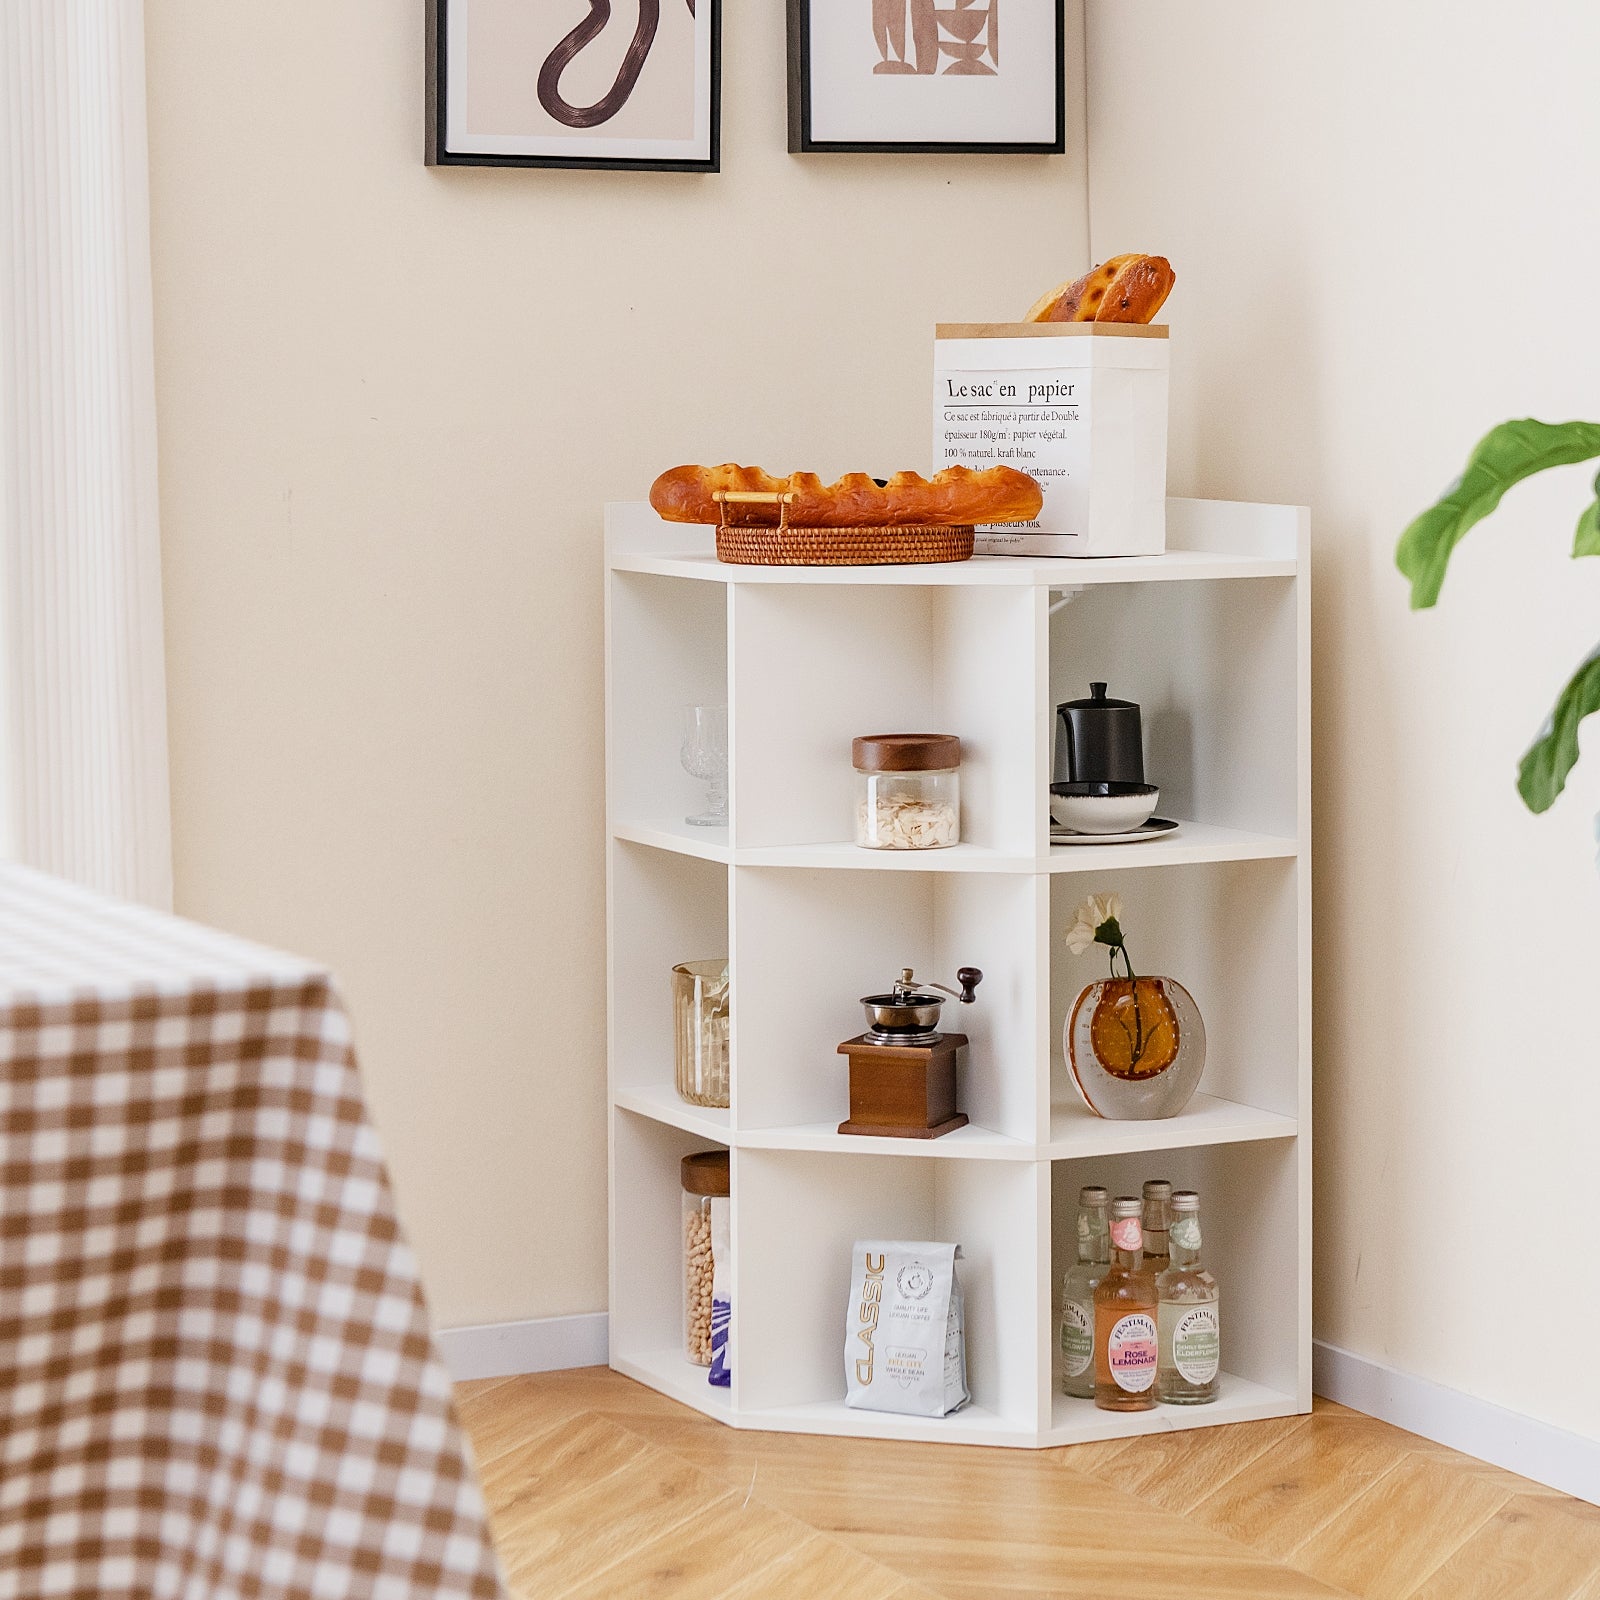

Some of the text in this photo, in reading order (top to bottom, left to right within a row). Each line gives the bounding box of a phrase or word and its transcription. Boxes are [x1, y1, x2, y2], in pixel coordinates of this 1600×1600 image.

[947, 379, 1074, 403] Le sac en papier
[944, 411, 955, 421] Ce
[957, 413, 968, 421] sac
[970, 412, 979, 421] est
[981, 411, 1012, 424] fabriqué
[1018, 412, 1039, 424] partir
[1041, 411, 1050, 421] de
[1051, 410, 1079, 421] Double
[944, 430, 977, 442] épaisseur
[1013, 430, 1036, 442] papier
[944, 448, 958, 458] 100
[960, 448, 967, 458] %
[997, 448, 1015, 458] kraft
[1016, 448, 1036, 458] blanc
[856, 1253, 885, 1386] CLASSIC
[1114, 1319, 1154, 1340] FENTIMANS
[1113, 1355, 1156, 1366] LEMONADE
[1124, 1350, 1148, 1359] ROSE
